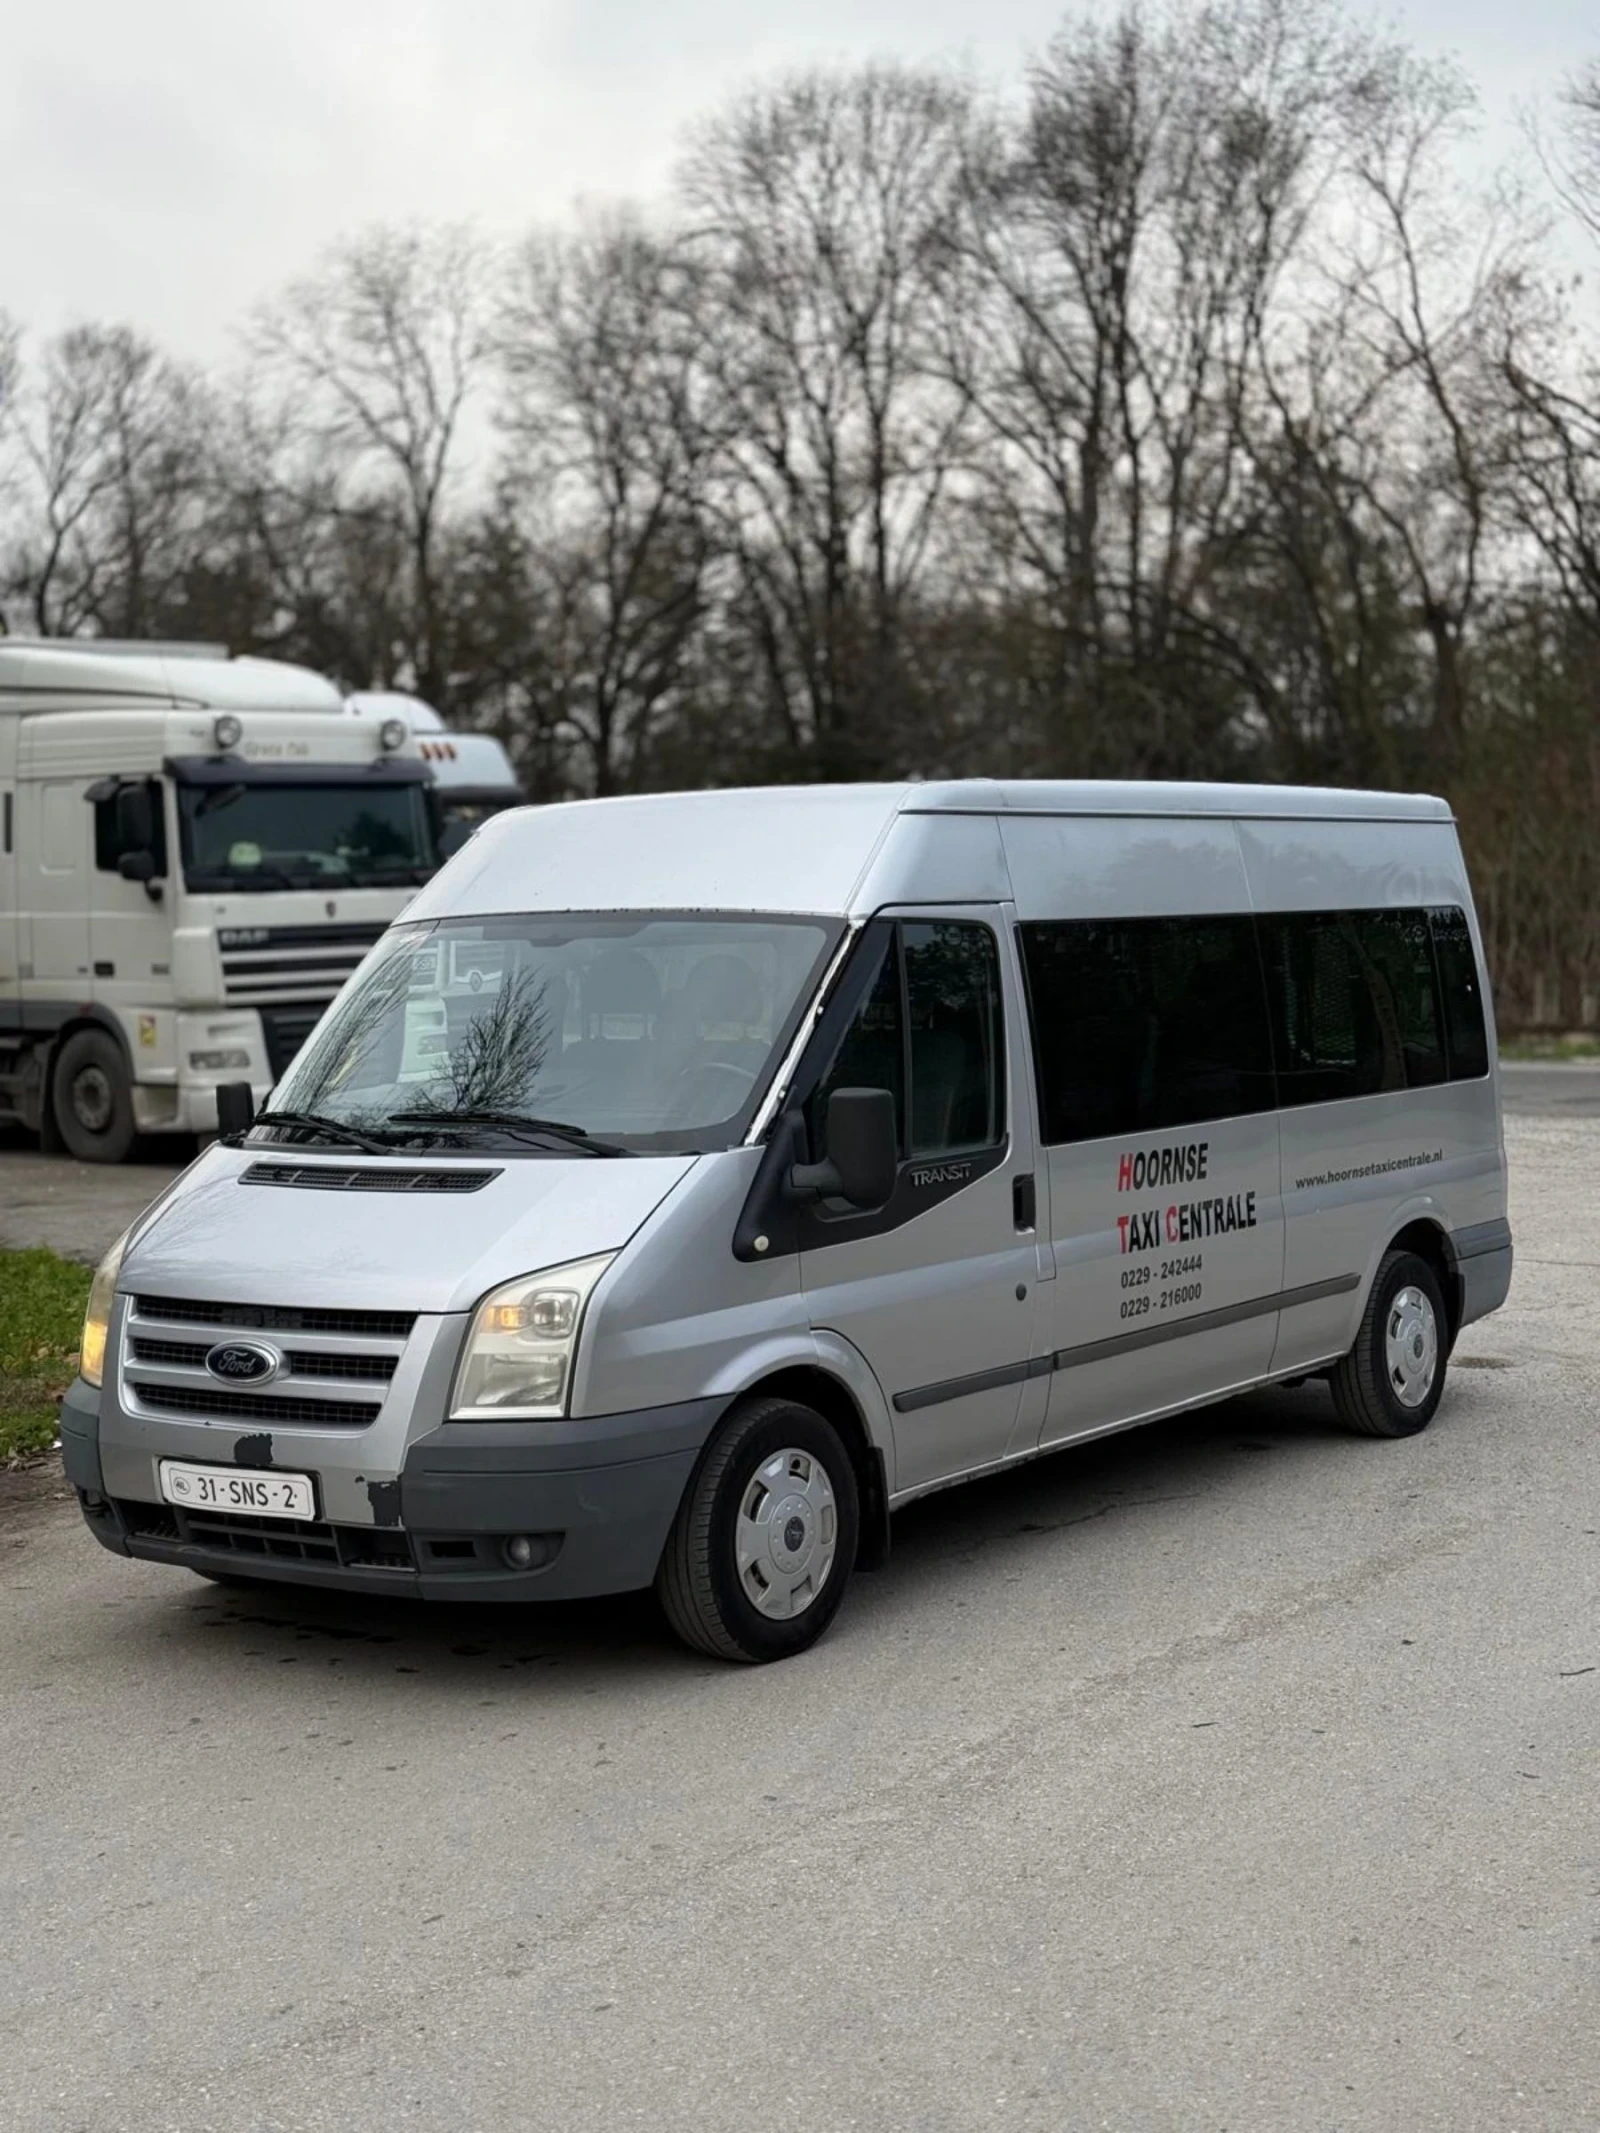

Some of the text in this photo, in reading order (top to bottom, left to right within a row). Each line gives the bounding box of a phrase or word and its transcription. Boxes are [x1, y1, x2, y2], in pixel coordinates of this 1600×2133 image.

[911, 1162, 971, 1186] TRANSIT
[1118, 1142, 1208, 1192] HOORNSE
[1295, 1148, 1443, 1189] www.hoornsetaxicentrale.nl
[1117, 1191, 1257, 1254] TAXI CENTRALE
[1121, 1266, 1150, 1289] 0229
[1161, 1253, 1202, 1279] 242444
[1120, 1296, 1150, 1319] 0229
[1160, 1282, 1202, 1309] 216000
[218, 1350, 257, 1373] Ford
